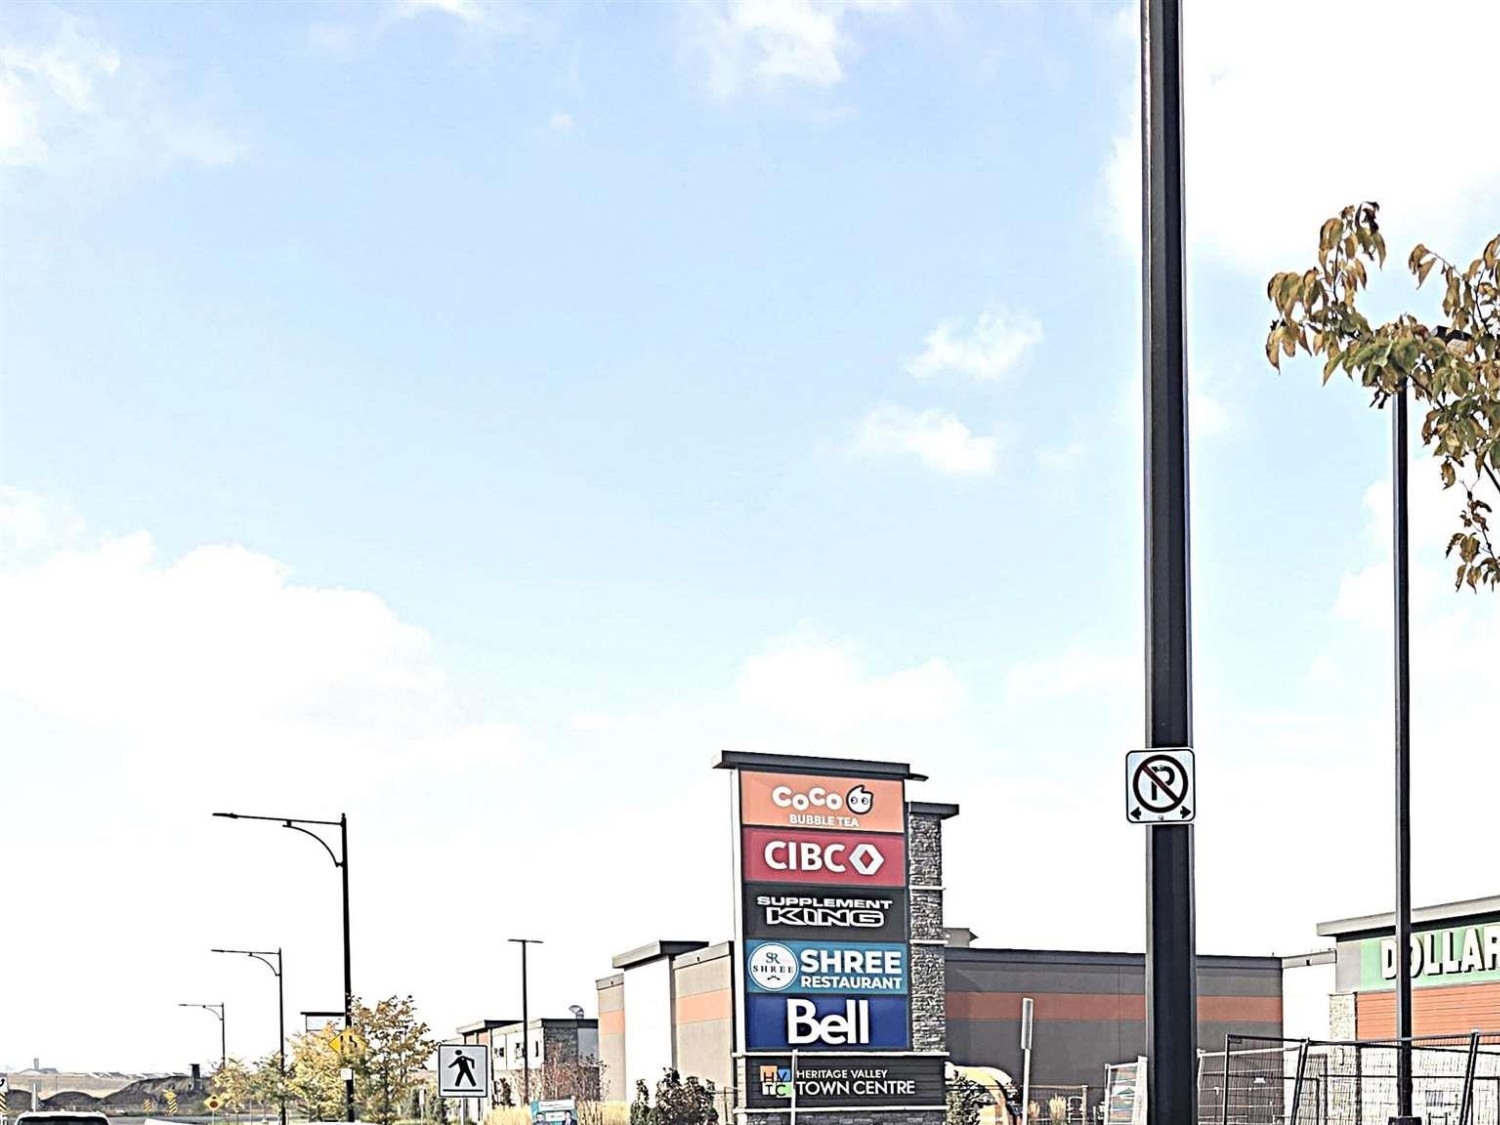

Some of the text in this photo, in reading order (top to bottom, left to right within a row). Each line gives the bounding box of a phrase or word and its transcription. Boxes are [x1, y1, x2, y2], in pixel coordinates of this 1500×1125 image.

[790, 814, 860, 828] BUBBLE TEA
[764, 841, 846, 872] CIBC
[757, 896, 893, 909] SUPPLEMENT
[766, 907, 885, 927] KING
[800, 949, 902, 974] SHREE
[753, 965, 794, 974] SHREE
[801, 976, 903, 989] RESTAURANT
[786, 998, 869, 1044] Bell
[796, 1069, 888, 1079] HERITAGE VALLEY
[796, 1081, 916, 1095] TOWN CENTRE
